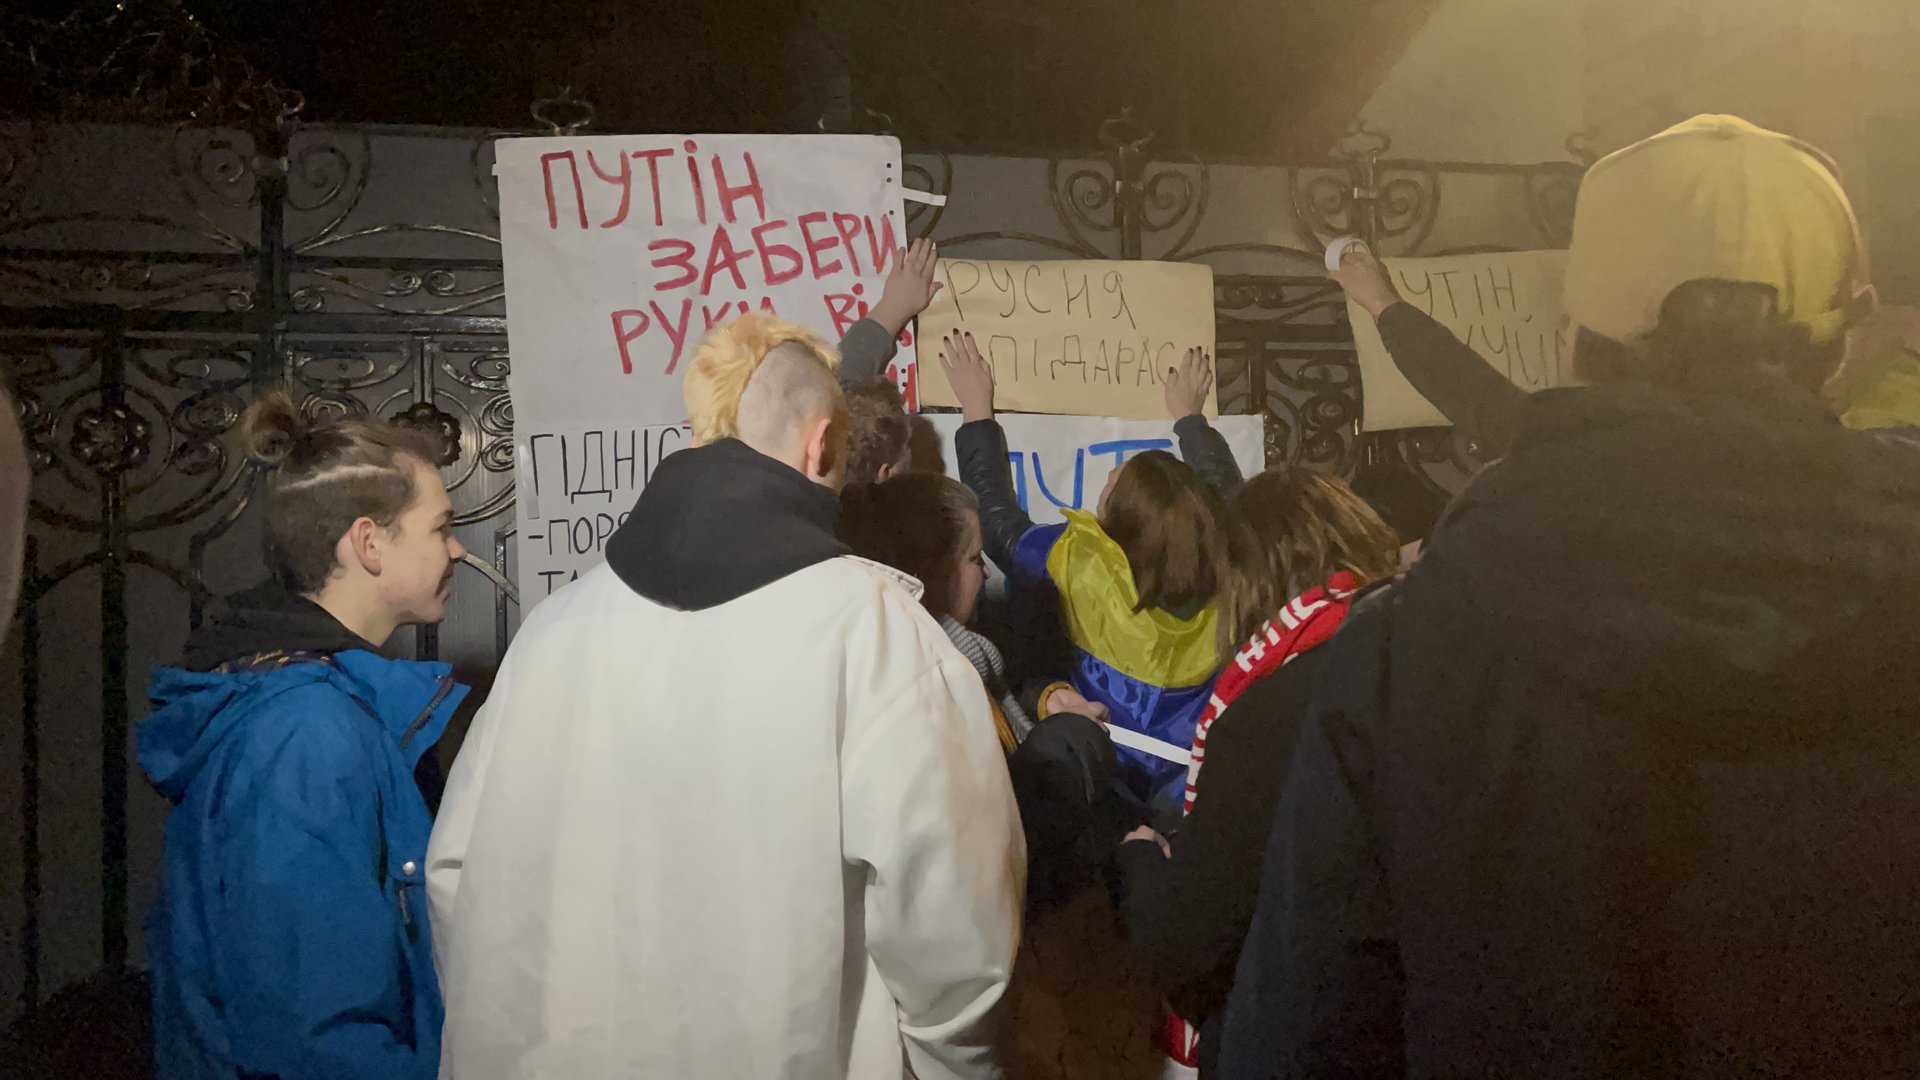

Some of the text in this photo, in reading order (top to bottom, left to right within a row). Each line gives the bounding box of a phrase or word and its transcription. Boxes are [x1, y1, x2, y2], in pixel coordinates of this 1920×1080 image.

[647, 211, 898, 296] ЗАБЕРИ
[1399, 265, 1517, 318] УТІН
[610, 296, 778, 375] РУ
[988, 334, 1210, 386] ПІДАРАС
[530, 426, 692, 505] ГІДНІС
